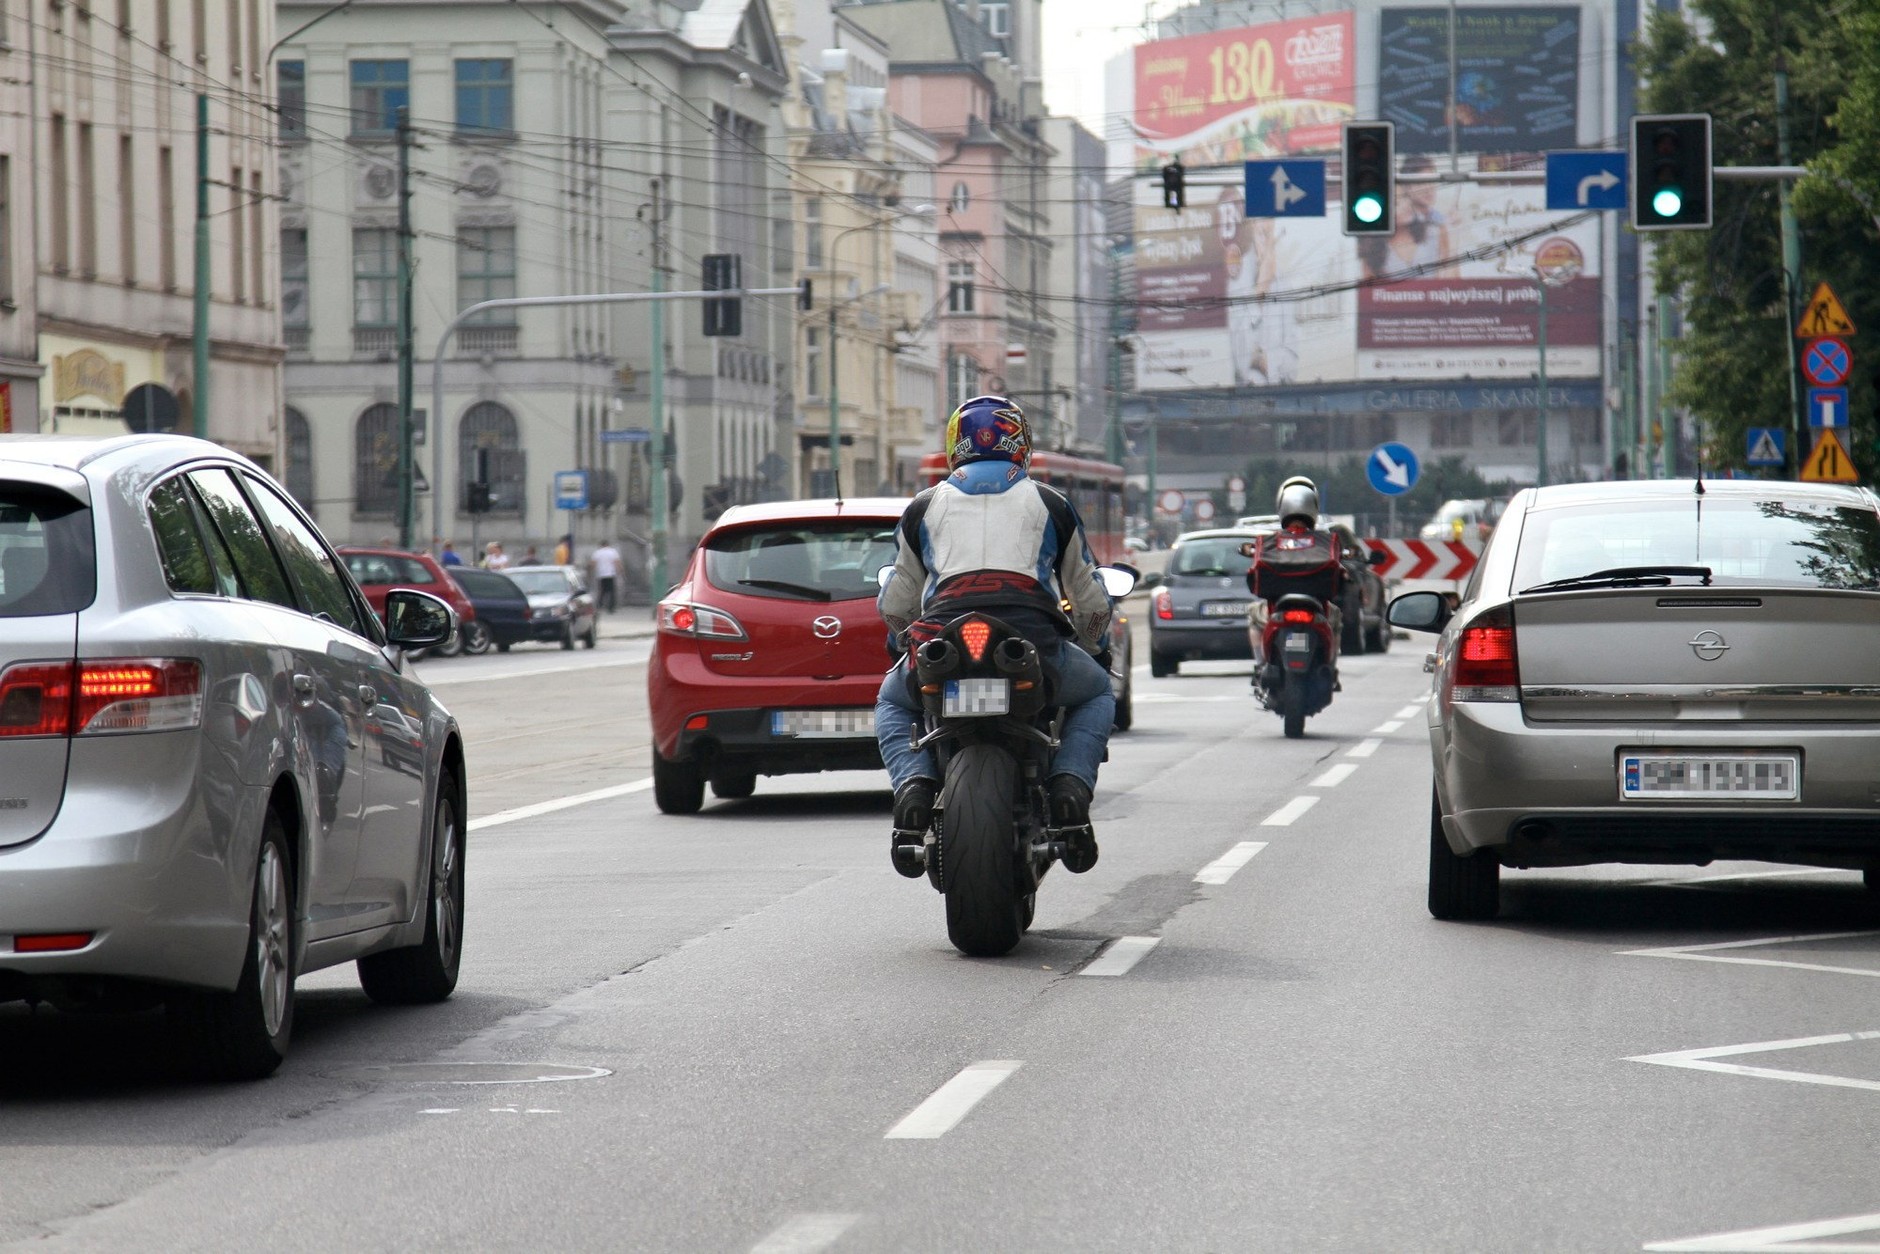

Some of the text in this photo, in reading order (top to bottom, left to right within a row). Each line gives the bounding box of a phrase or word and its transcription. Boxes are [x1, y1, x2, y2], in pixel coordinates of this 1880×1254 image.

[1210, 38, 1274, 103] 130
[1373, 287, 1426, 302] Finanse
[1430, 286, 1503, 304] najwyższej
[1368, 388, 1571, 410] GALERIA SKAREK
